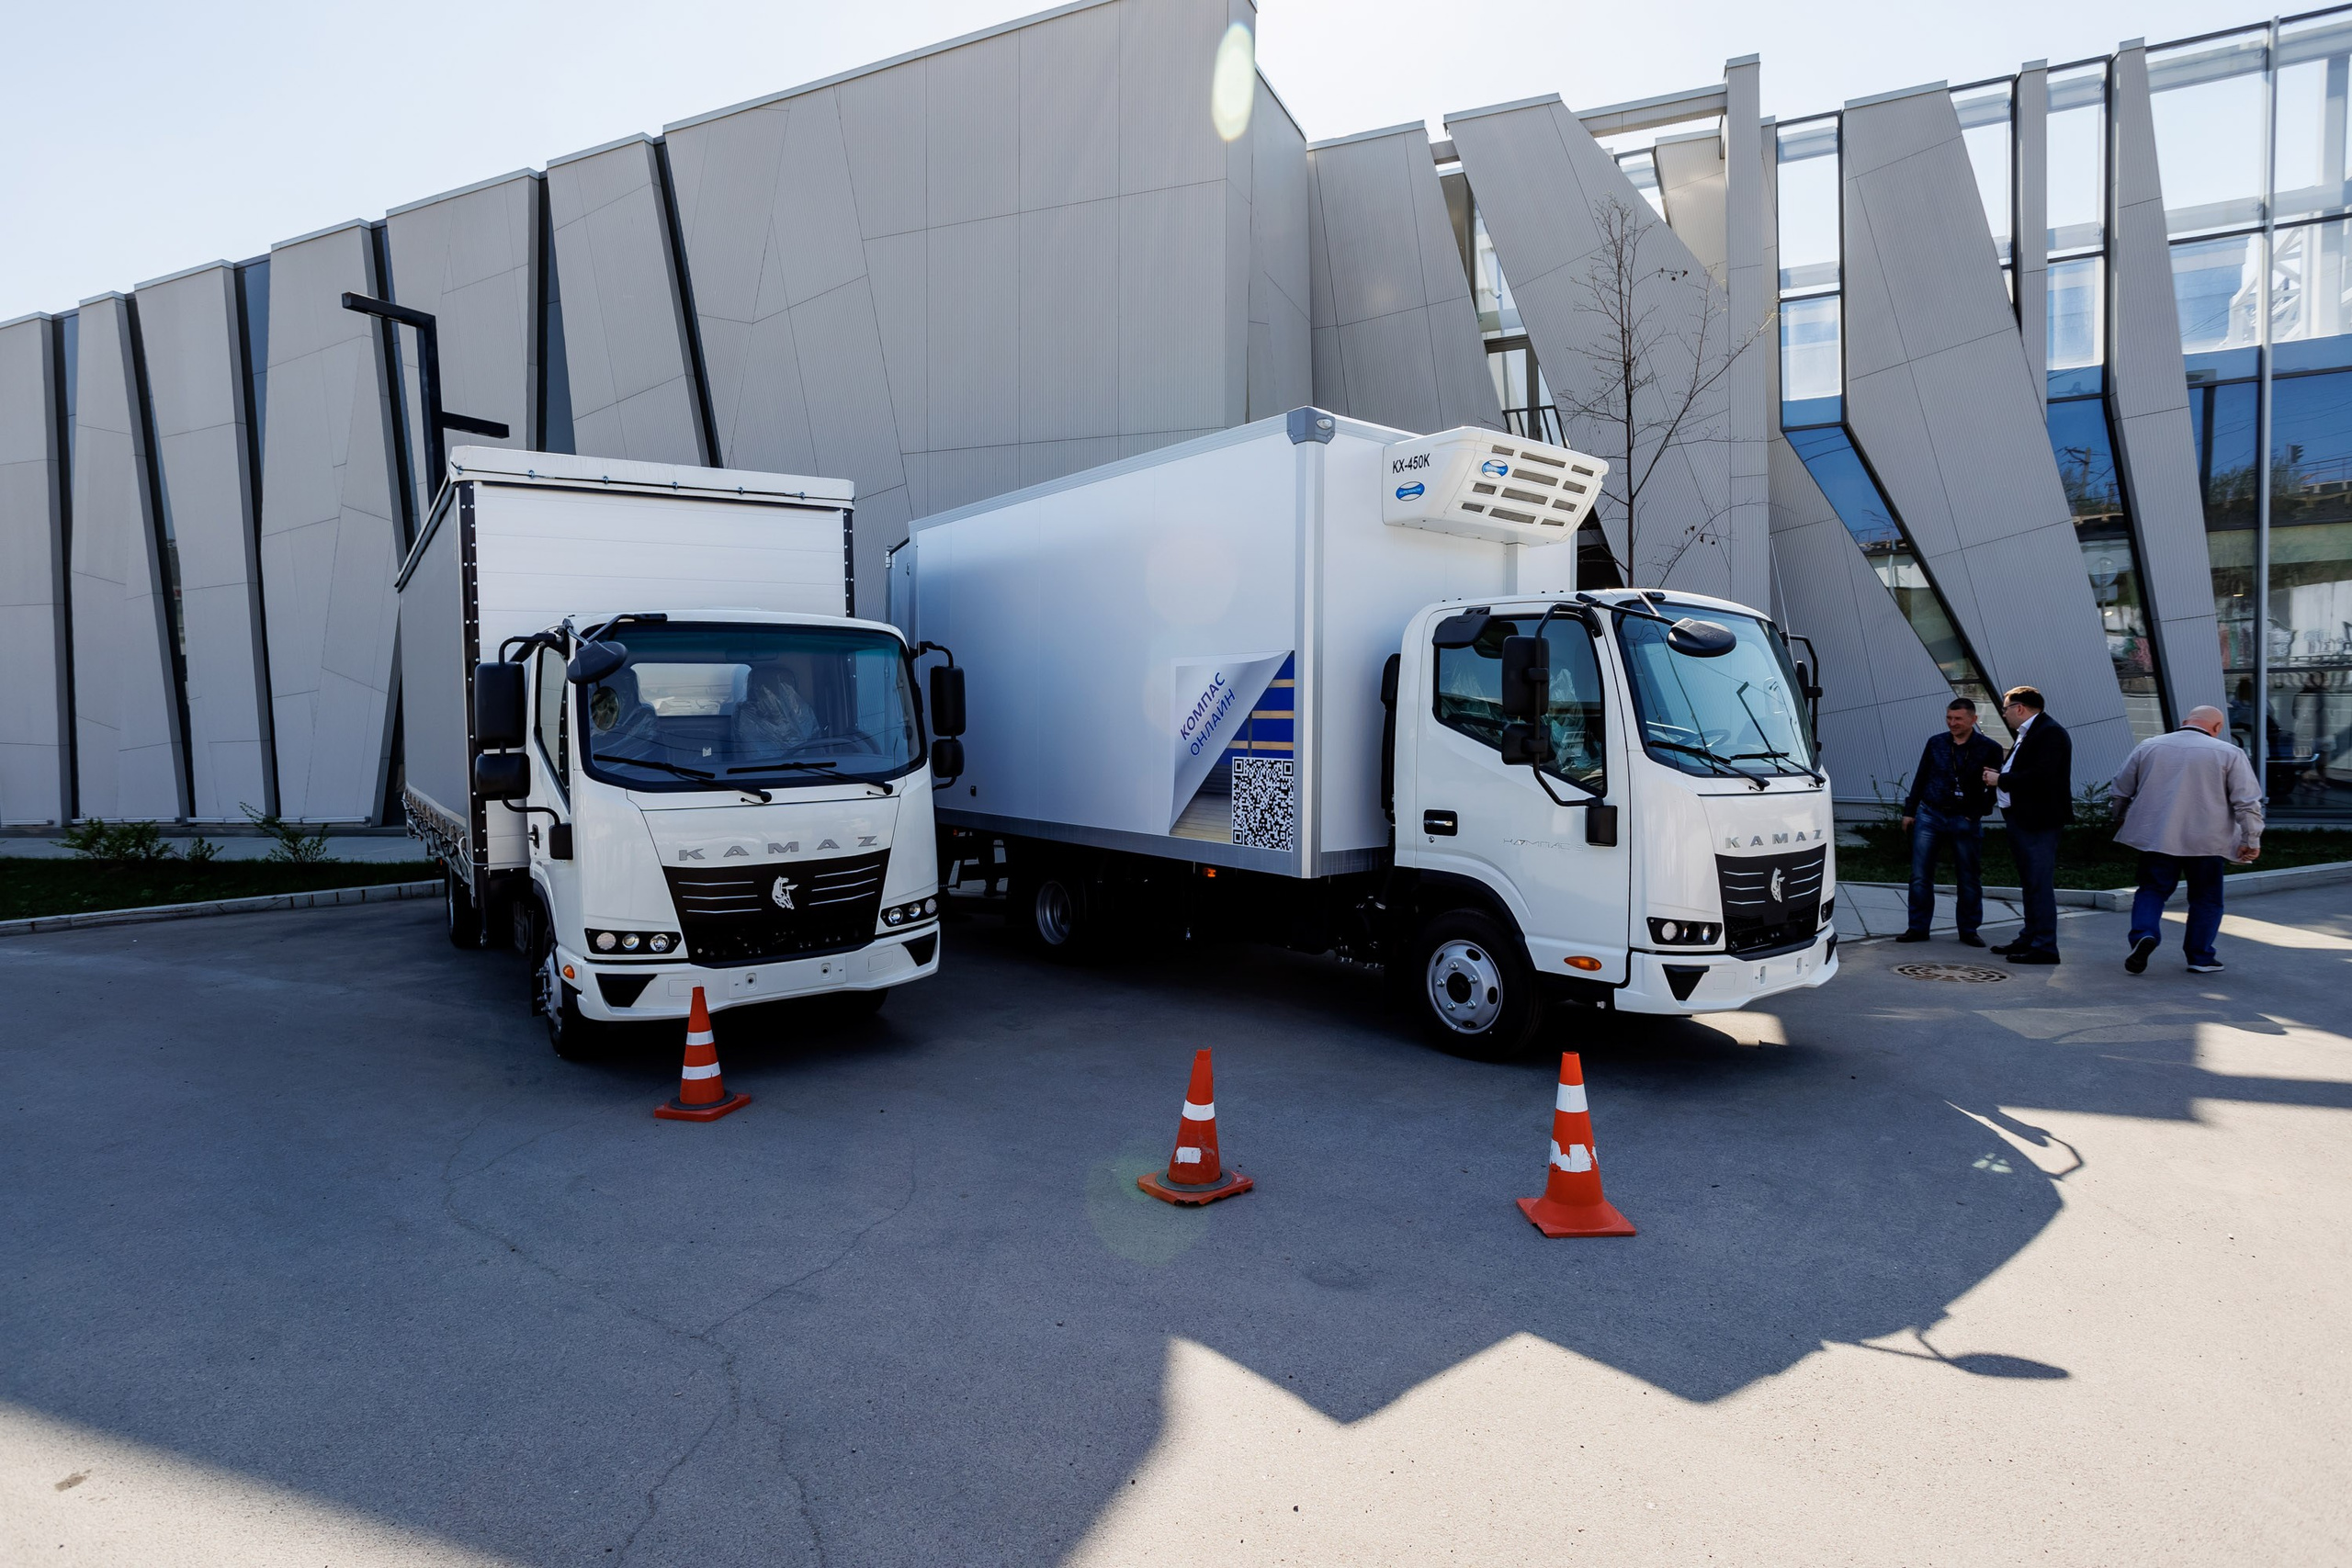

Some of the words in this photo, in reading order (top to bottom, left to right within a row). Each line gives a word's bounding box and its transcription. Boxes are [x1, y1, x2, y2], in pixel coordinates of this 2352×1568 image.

[1392, 453, 1430, 474] KX-450K
[1180, 672, 1226, 740] КОМПАС
[1190, 689, 1236, 756] ОНЛАЙН
[678, 835, 877, 861] KAMAZ
[1724, 829, 1823, 849] KAMAZ
